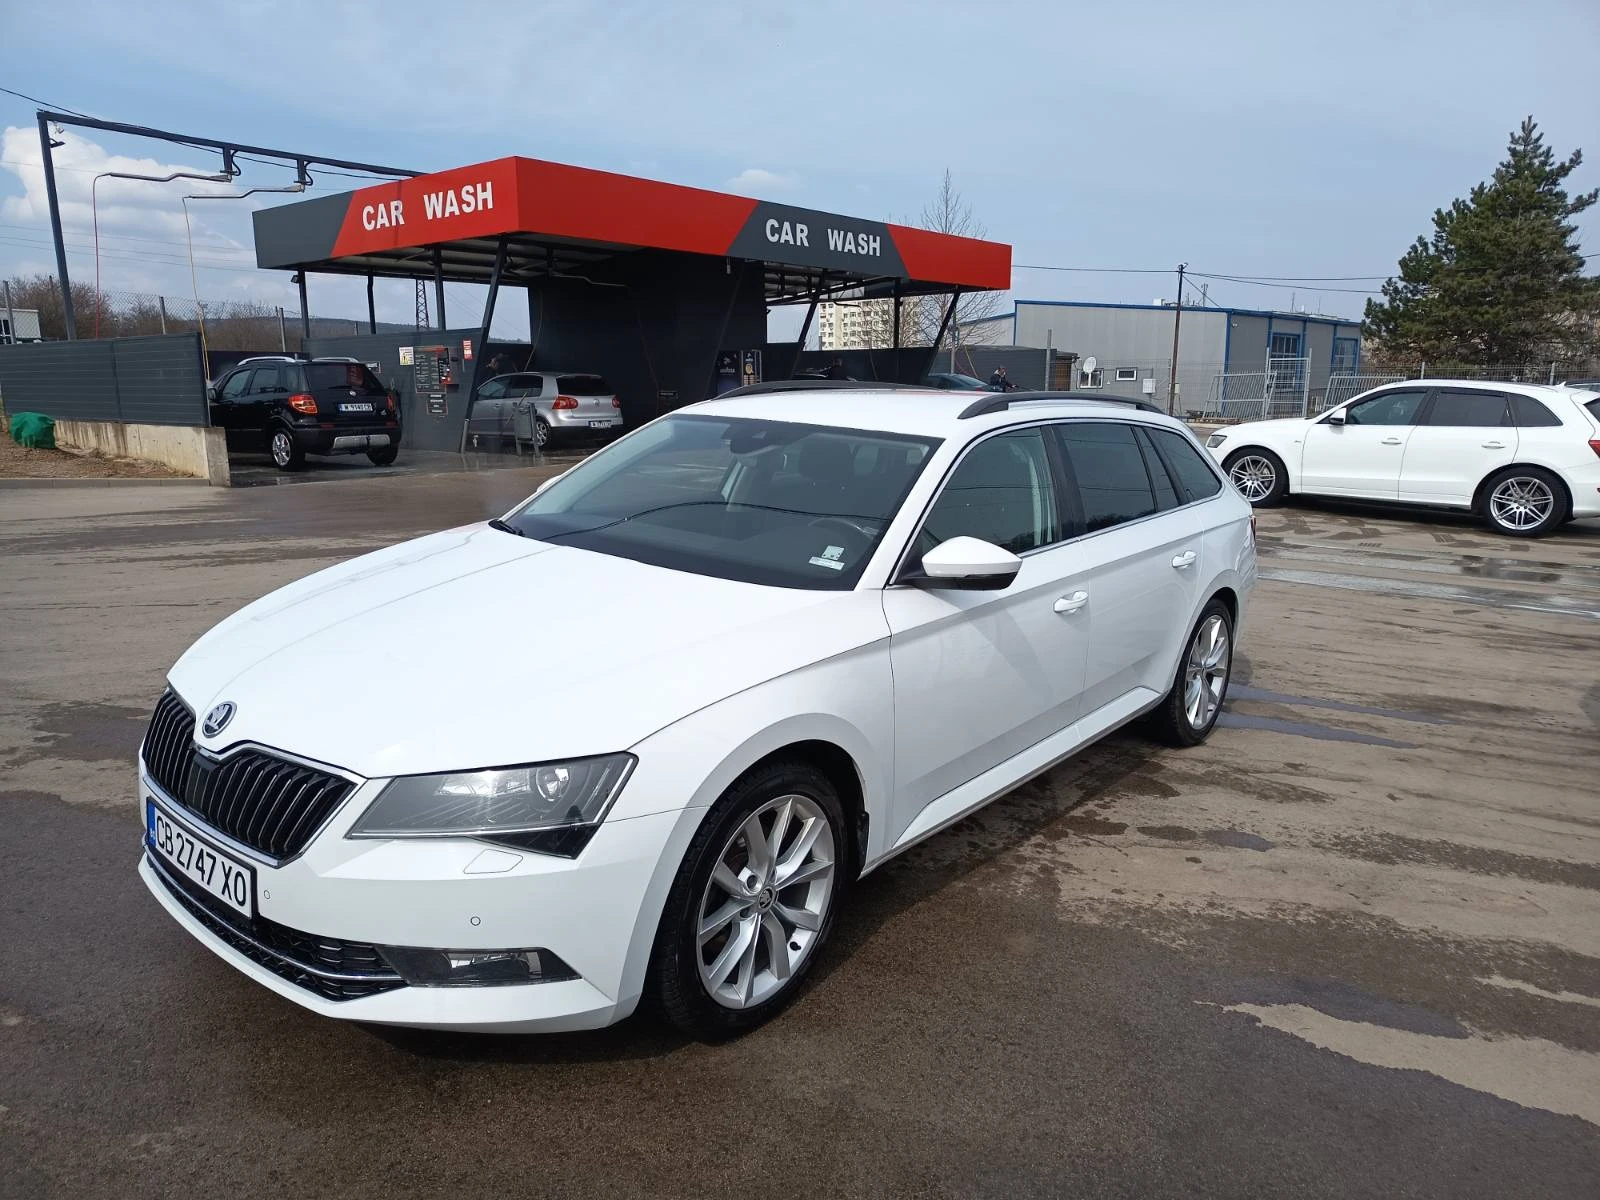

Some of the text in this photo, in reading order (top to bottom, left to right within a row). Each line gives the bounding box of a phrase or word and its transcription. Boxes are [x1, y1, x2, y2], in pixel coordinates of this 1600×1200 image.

[362, 181, 494, 231] CAR WASH
[765, 218, 881, 257] CAR WASH
[156, 815, 247, 907] CB 2747 XO
